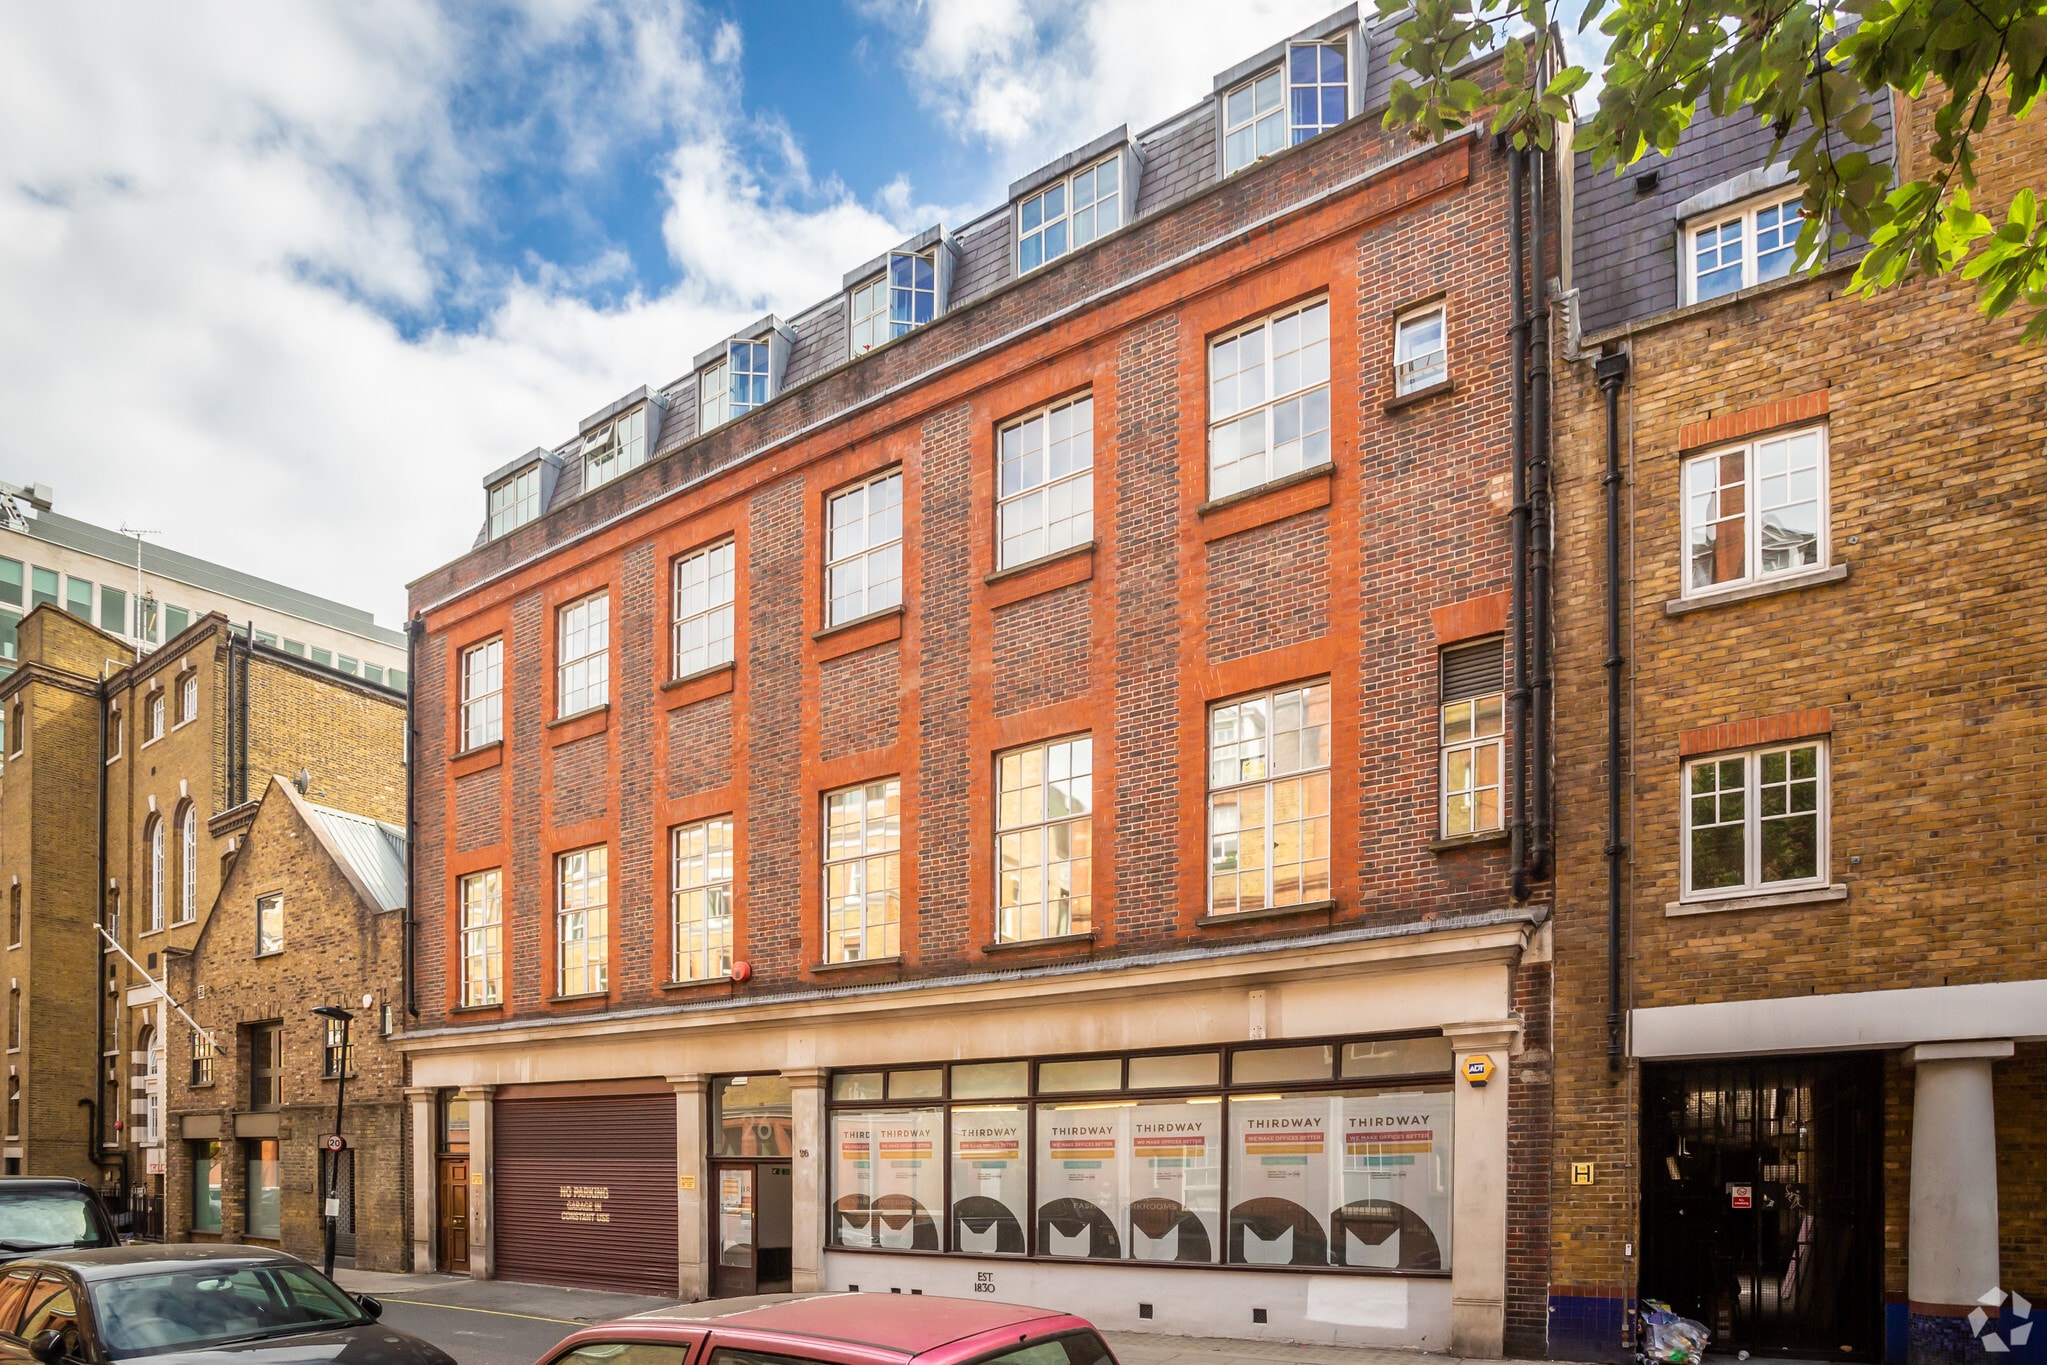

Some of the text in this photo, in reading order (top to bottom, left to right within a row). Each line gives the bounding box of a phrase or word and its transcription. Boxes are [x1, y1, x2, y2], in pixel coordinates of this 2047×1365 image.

[1248, 1118, 1322, 1129] THIRDWAY
[1349, 1115, 1430, 1127] THIRDWAY
[961, 1128, 1017, 1137] THIRDWAY
[1052, 1126, 1113, 1135] THIRDWAY
[1136, 1123, 1202, 1132] THIRDWAY
[880, 1129, 931, 1138] THIRDWAY
[1575, 1165, 1590, 1182] H
[560, 1186, 609, 1199] NO PARKING
[561, 1211, 610, 1222] CONSTANT USE
[974, 1282, 996, 1293] 1830
